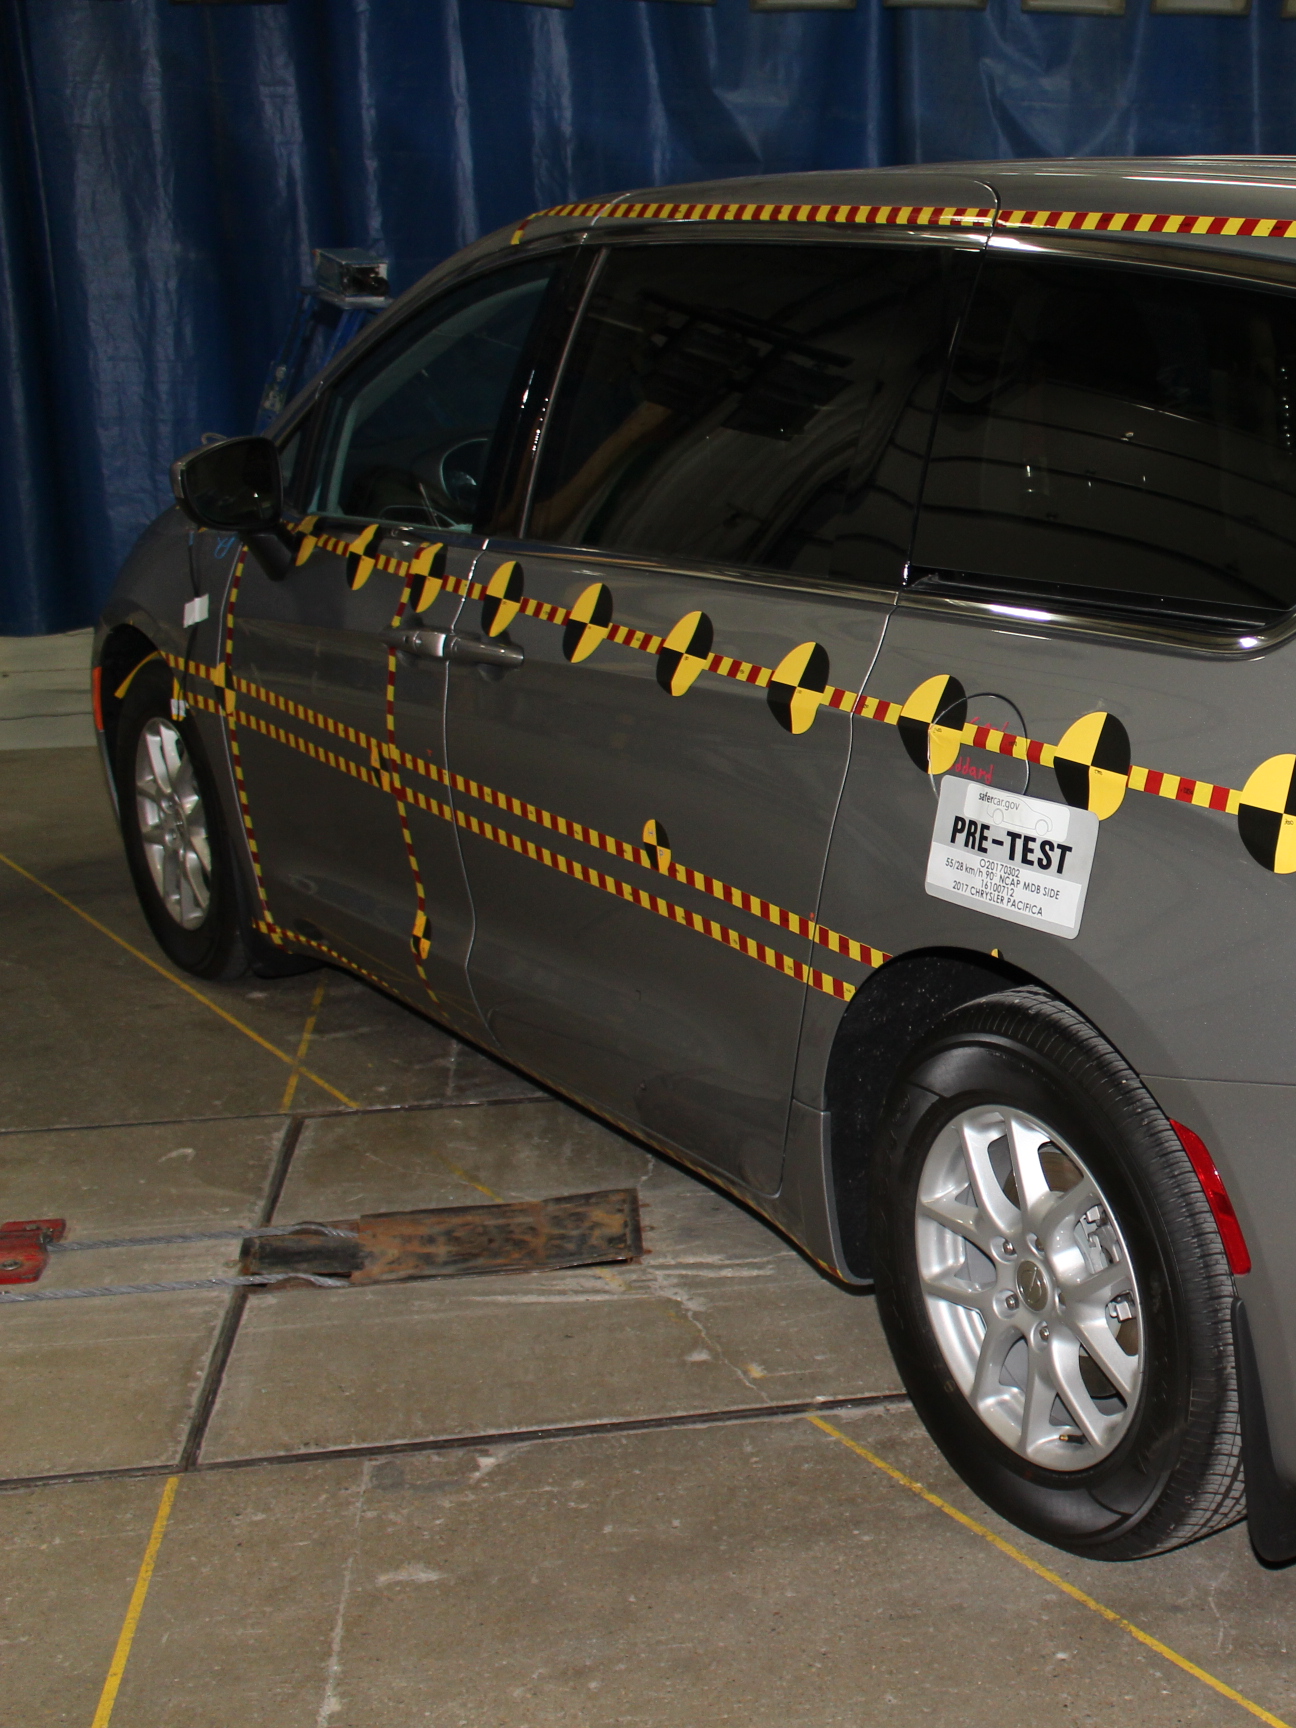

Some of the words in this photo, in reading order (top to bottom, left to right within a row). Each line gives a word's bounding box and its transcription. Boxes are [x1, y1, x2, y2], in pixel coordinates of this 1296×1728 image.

[978, 791, 1020, 811] safercar.gov
[950, 815, 1073, 875] PRE-TEST
[945, 857, 964, 872] 55/28
[964, 862, 984, 878] km/h
[999, 872, 1021, 889] NCAP
[1022, 878, 1041, 894] MDB
[1043, 884, 1060, 900] SIDE
[980, 879, 1015, 898] 16100712
[952, 879, 970, 893] 2017
[970, 884, 1005, 905] CHRYSLER
[1006, 896, 1043, 917] PACIFICA
